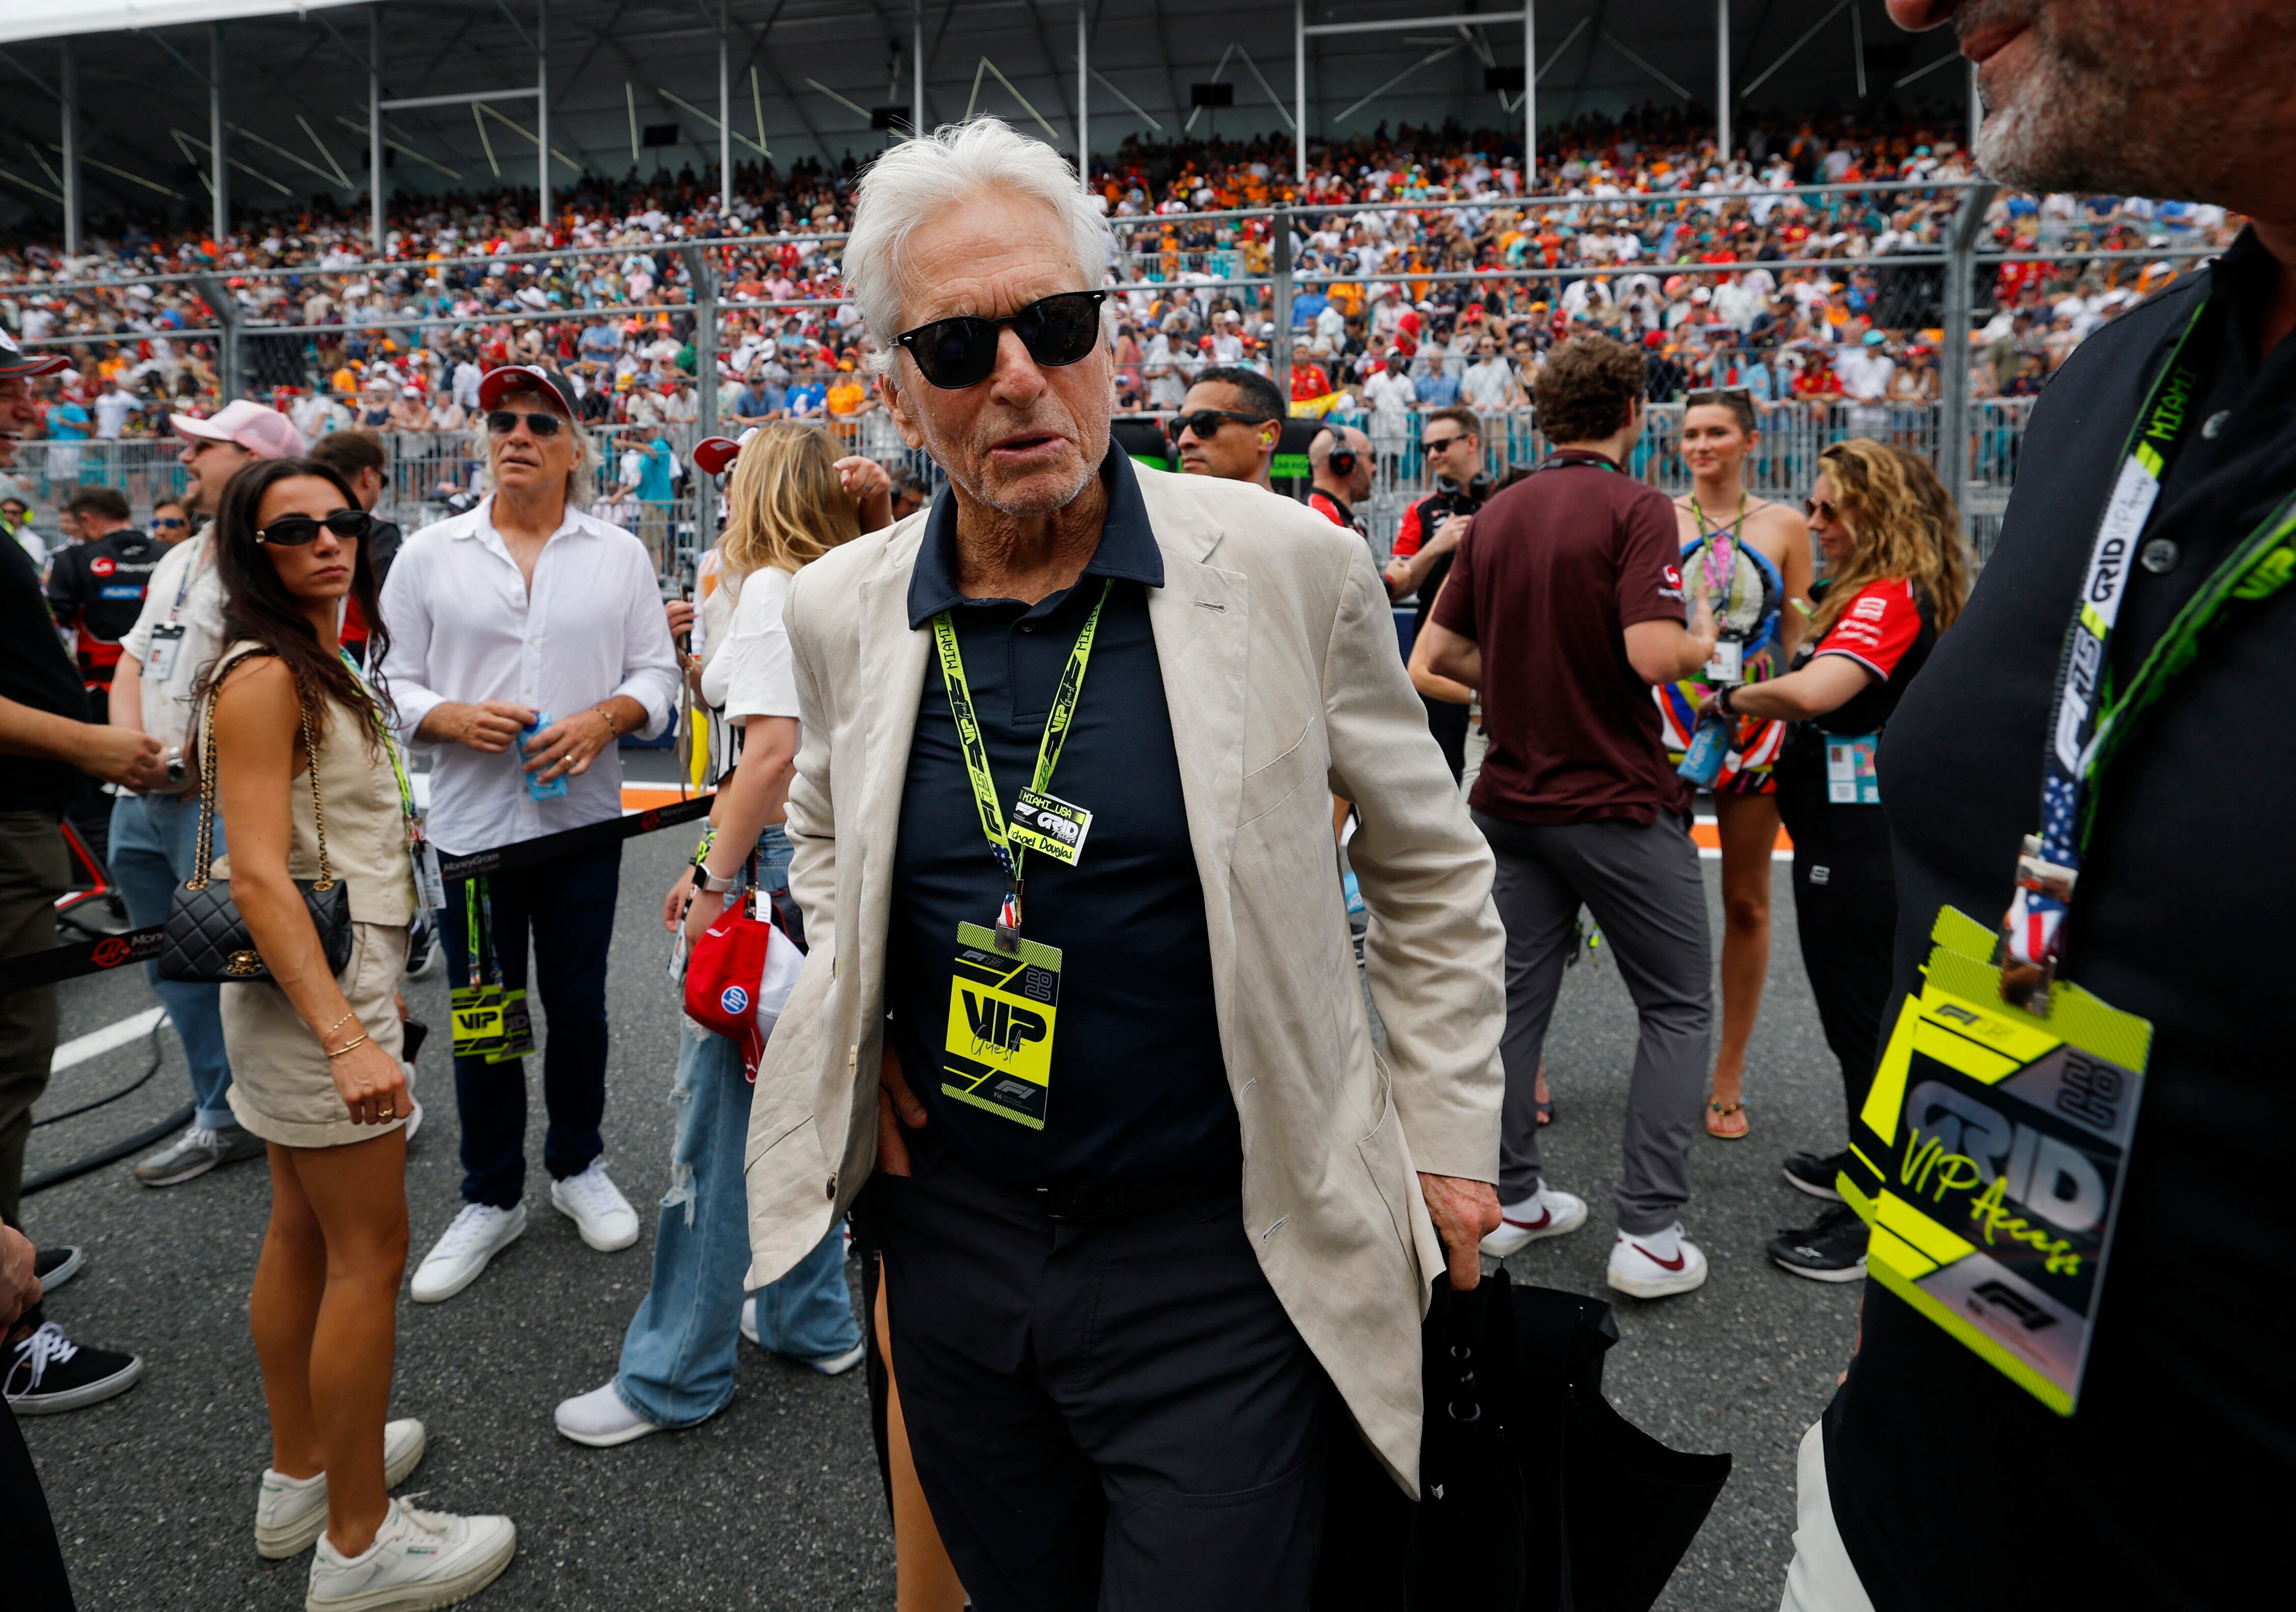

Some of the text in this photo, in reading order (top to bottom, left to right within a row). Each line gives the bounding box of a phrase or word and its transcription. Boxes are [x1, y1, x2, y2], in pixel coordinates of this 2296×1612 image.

[2146, 363, 2197, 441] MIAMI
[2090, 538, 2125, 603] GRID
[938, 626, 958, 670] MIAMI
[954, 699, 977, 745] VIP Guest
[1050, 682, 1075, 733] VIP Guest
[1037, 812, 1079, 837] GRID
[1051, 827, 1077, 844] Access
[1039, 837, 1073, 859] Douglas
[458, 1011, 498, 1029] VIP
[723, 989, 746, 1010] hp
[961, 989, 1047, 1052] VIP
[971, 1024, 1026, 1066] Guest
[1906, 1080, 2105, 1232] GRID
[1901, 1128, 2083, 1276] VIP Access
